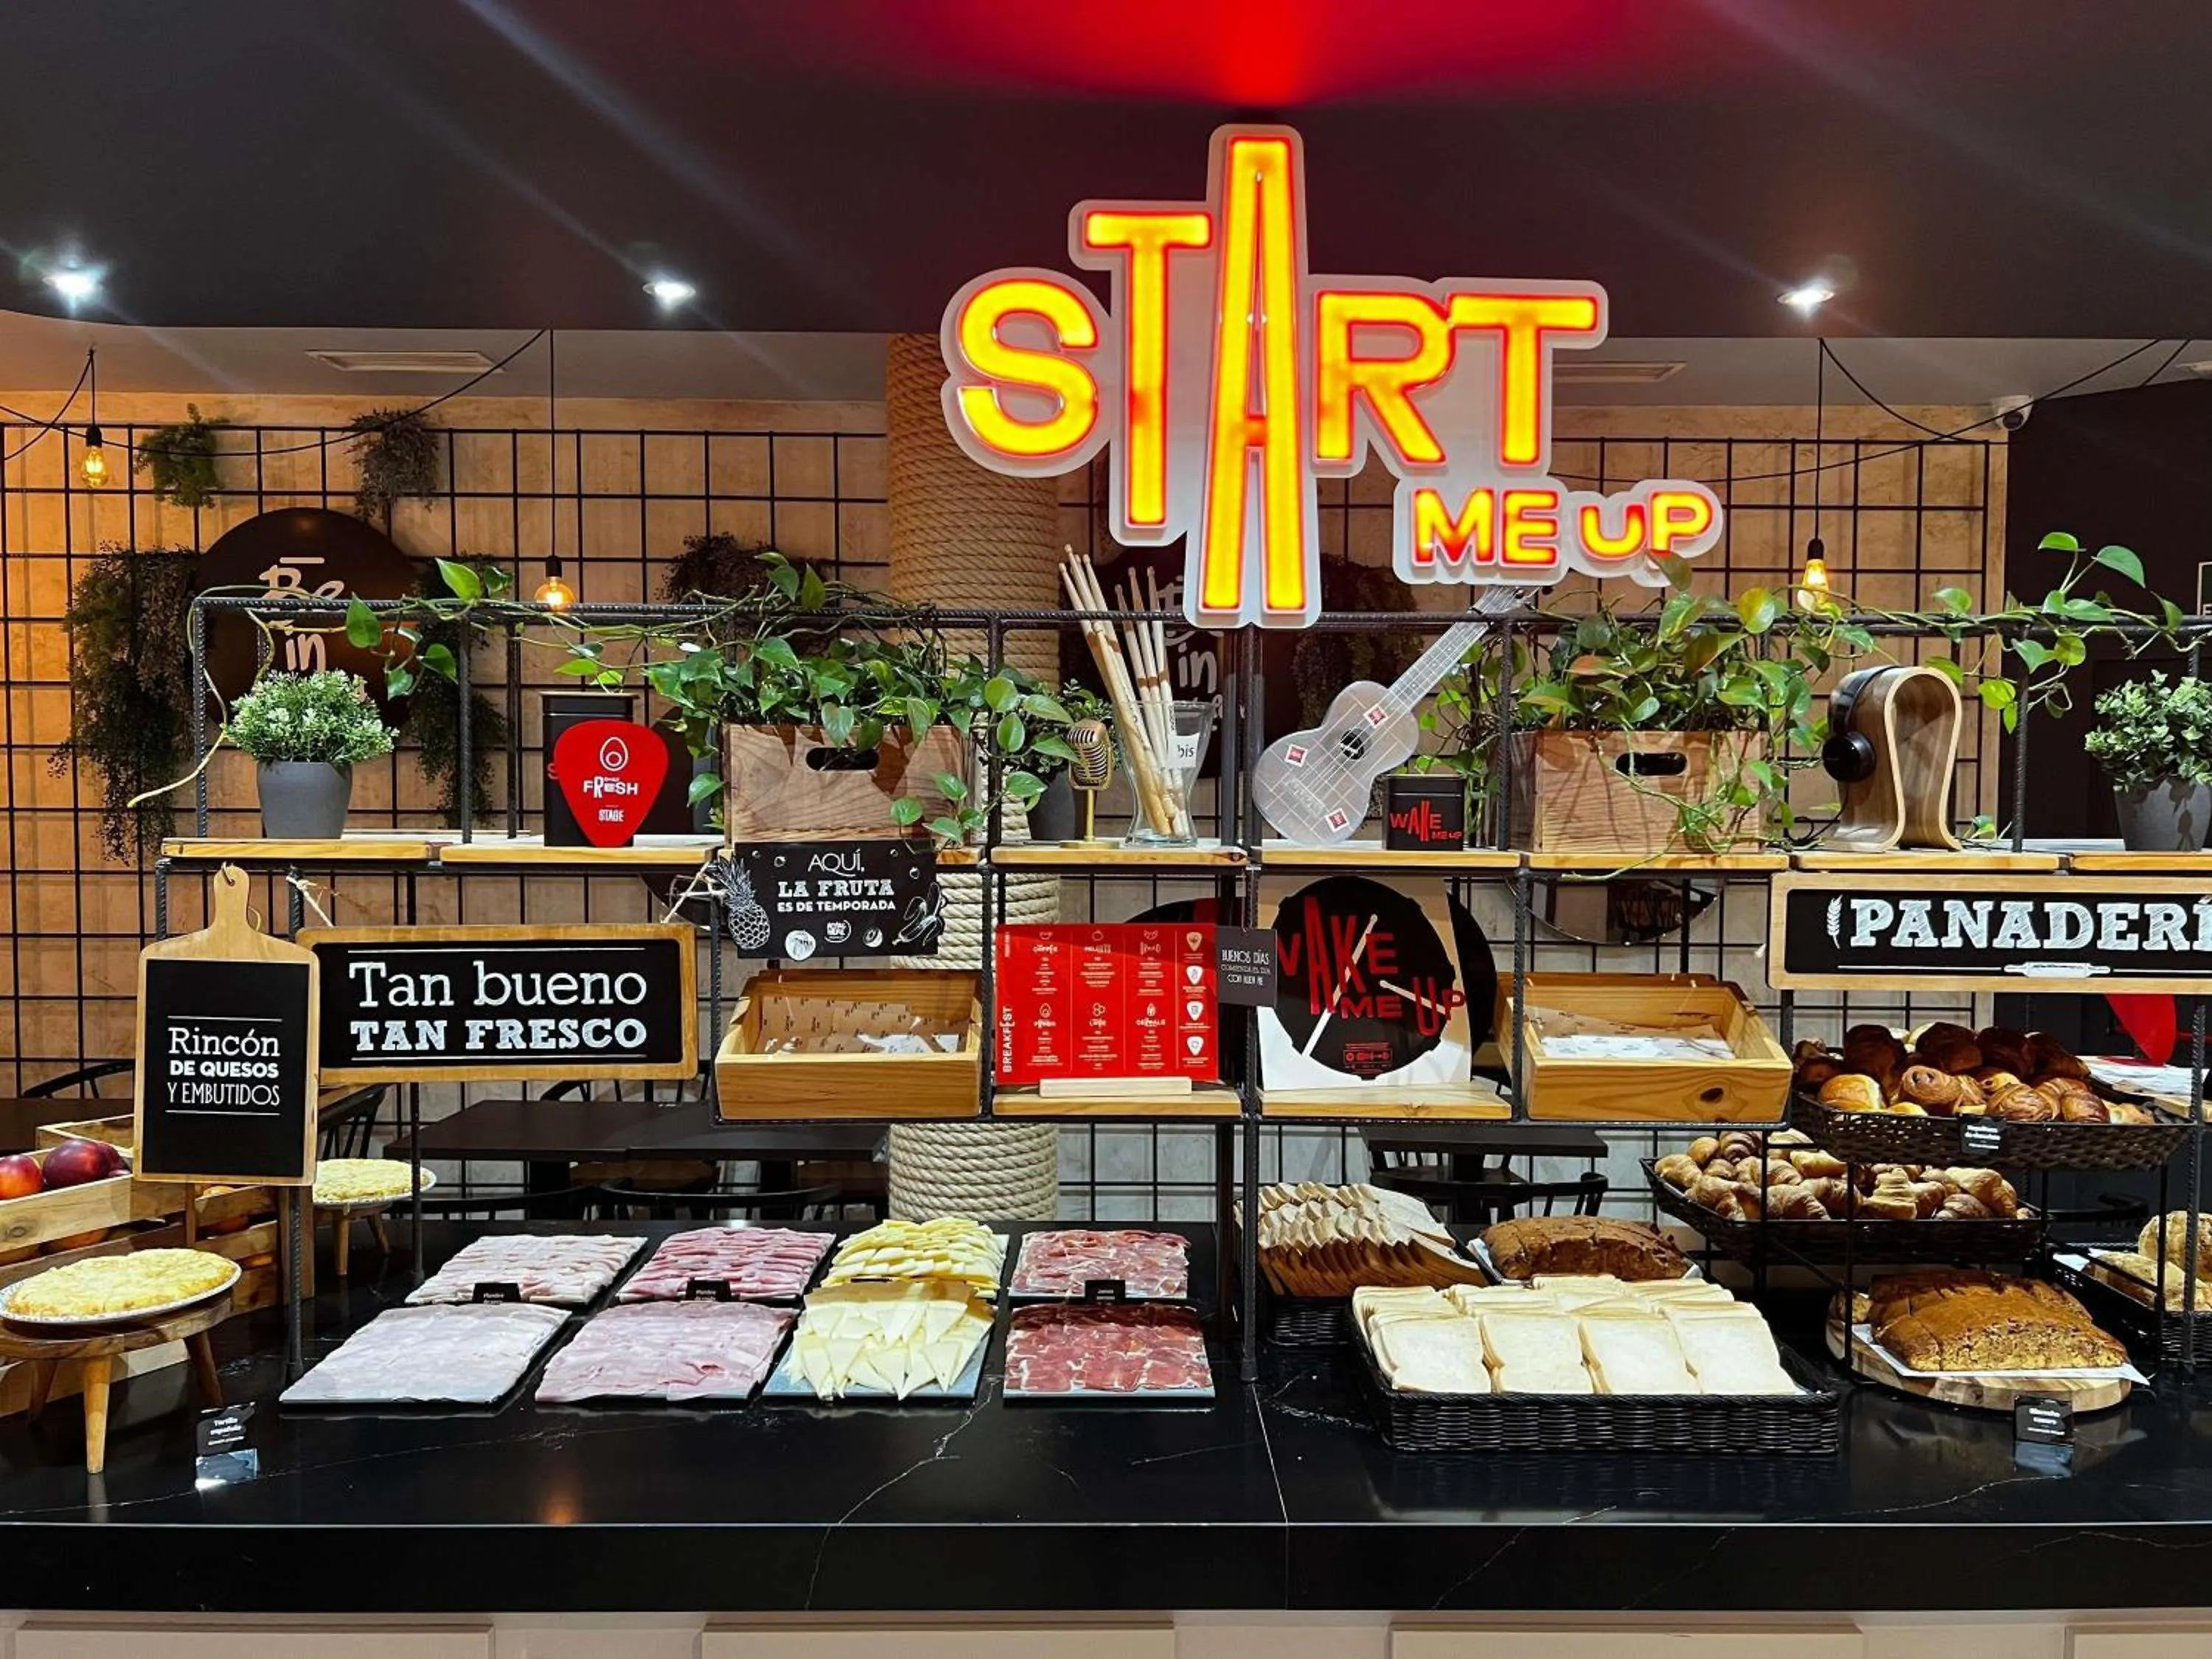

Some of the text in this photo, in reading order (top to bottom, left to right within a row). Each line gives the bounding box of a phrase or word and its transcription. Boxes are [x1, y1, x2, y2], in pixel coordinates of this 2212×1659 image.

[956, 134, 1600, 613] START
[1412, 487, 1715, 571] ME UP
[1178, 640, 1218, 695] in
[582, 776, 639, 799] FRESH
[778, 879, 895, 897] LA FRUTA
[777, 900, 897, 913] ES DE TEMPORADA
[349, 960, 647, 1007] Tan bueno
[1339, 976, 1466, 1037] ME UP
[167, 1026, 281, 1058] Rincón
[349, 1018, 647, 1051] TAN FRESCO
[170, 1060, 280, 1079] DE QUESOS
[167, 1081, 281, 1107] Y EMBUTIDOS
